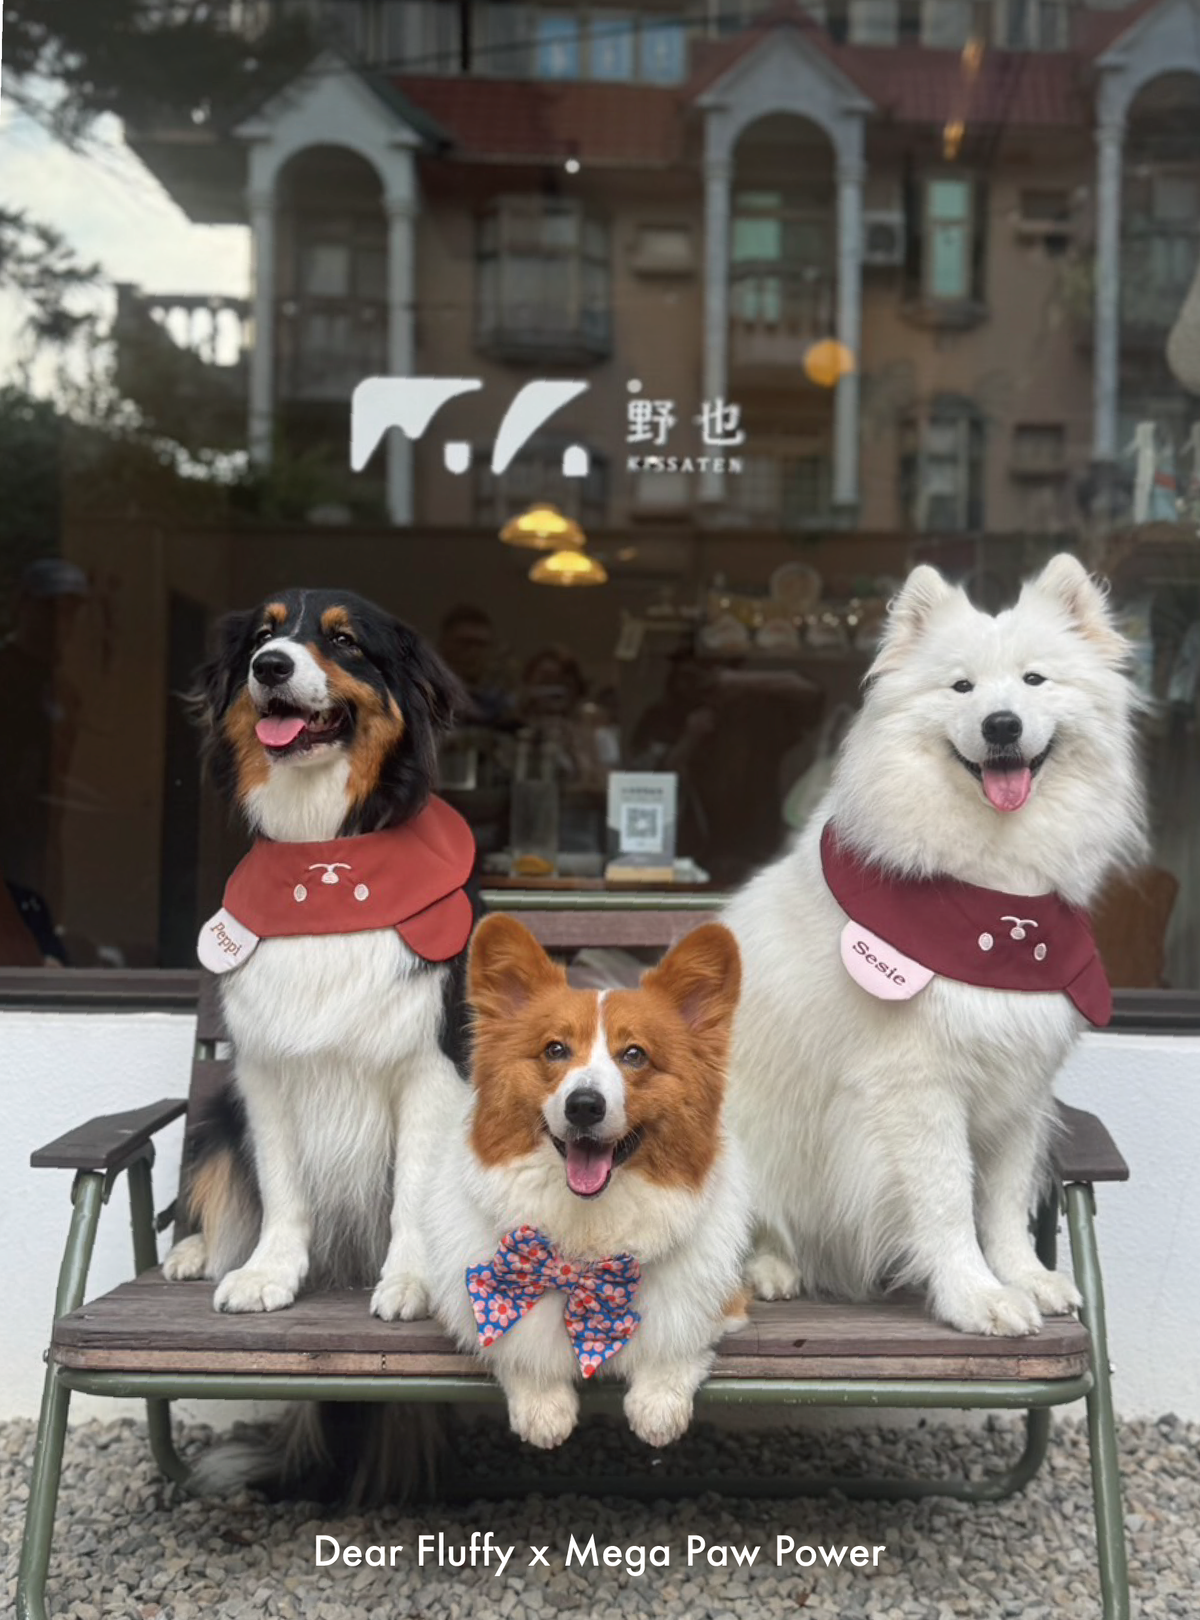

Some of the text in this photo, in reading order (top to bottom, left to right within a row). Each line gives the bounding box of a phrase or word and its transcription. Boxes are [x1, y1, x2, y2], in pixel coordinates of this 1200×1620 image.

[626, 398, 746, 446] 野也
[627, 456, 744, 473] KISSATEN
[210, 922, 242, 956] Peppi
[852, 940, 906, 986] Sesie
